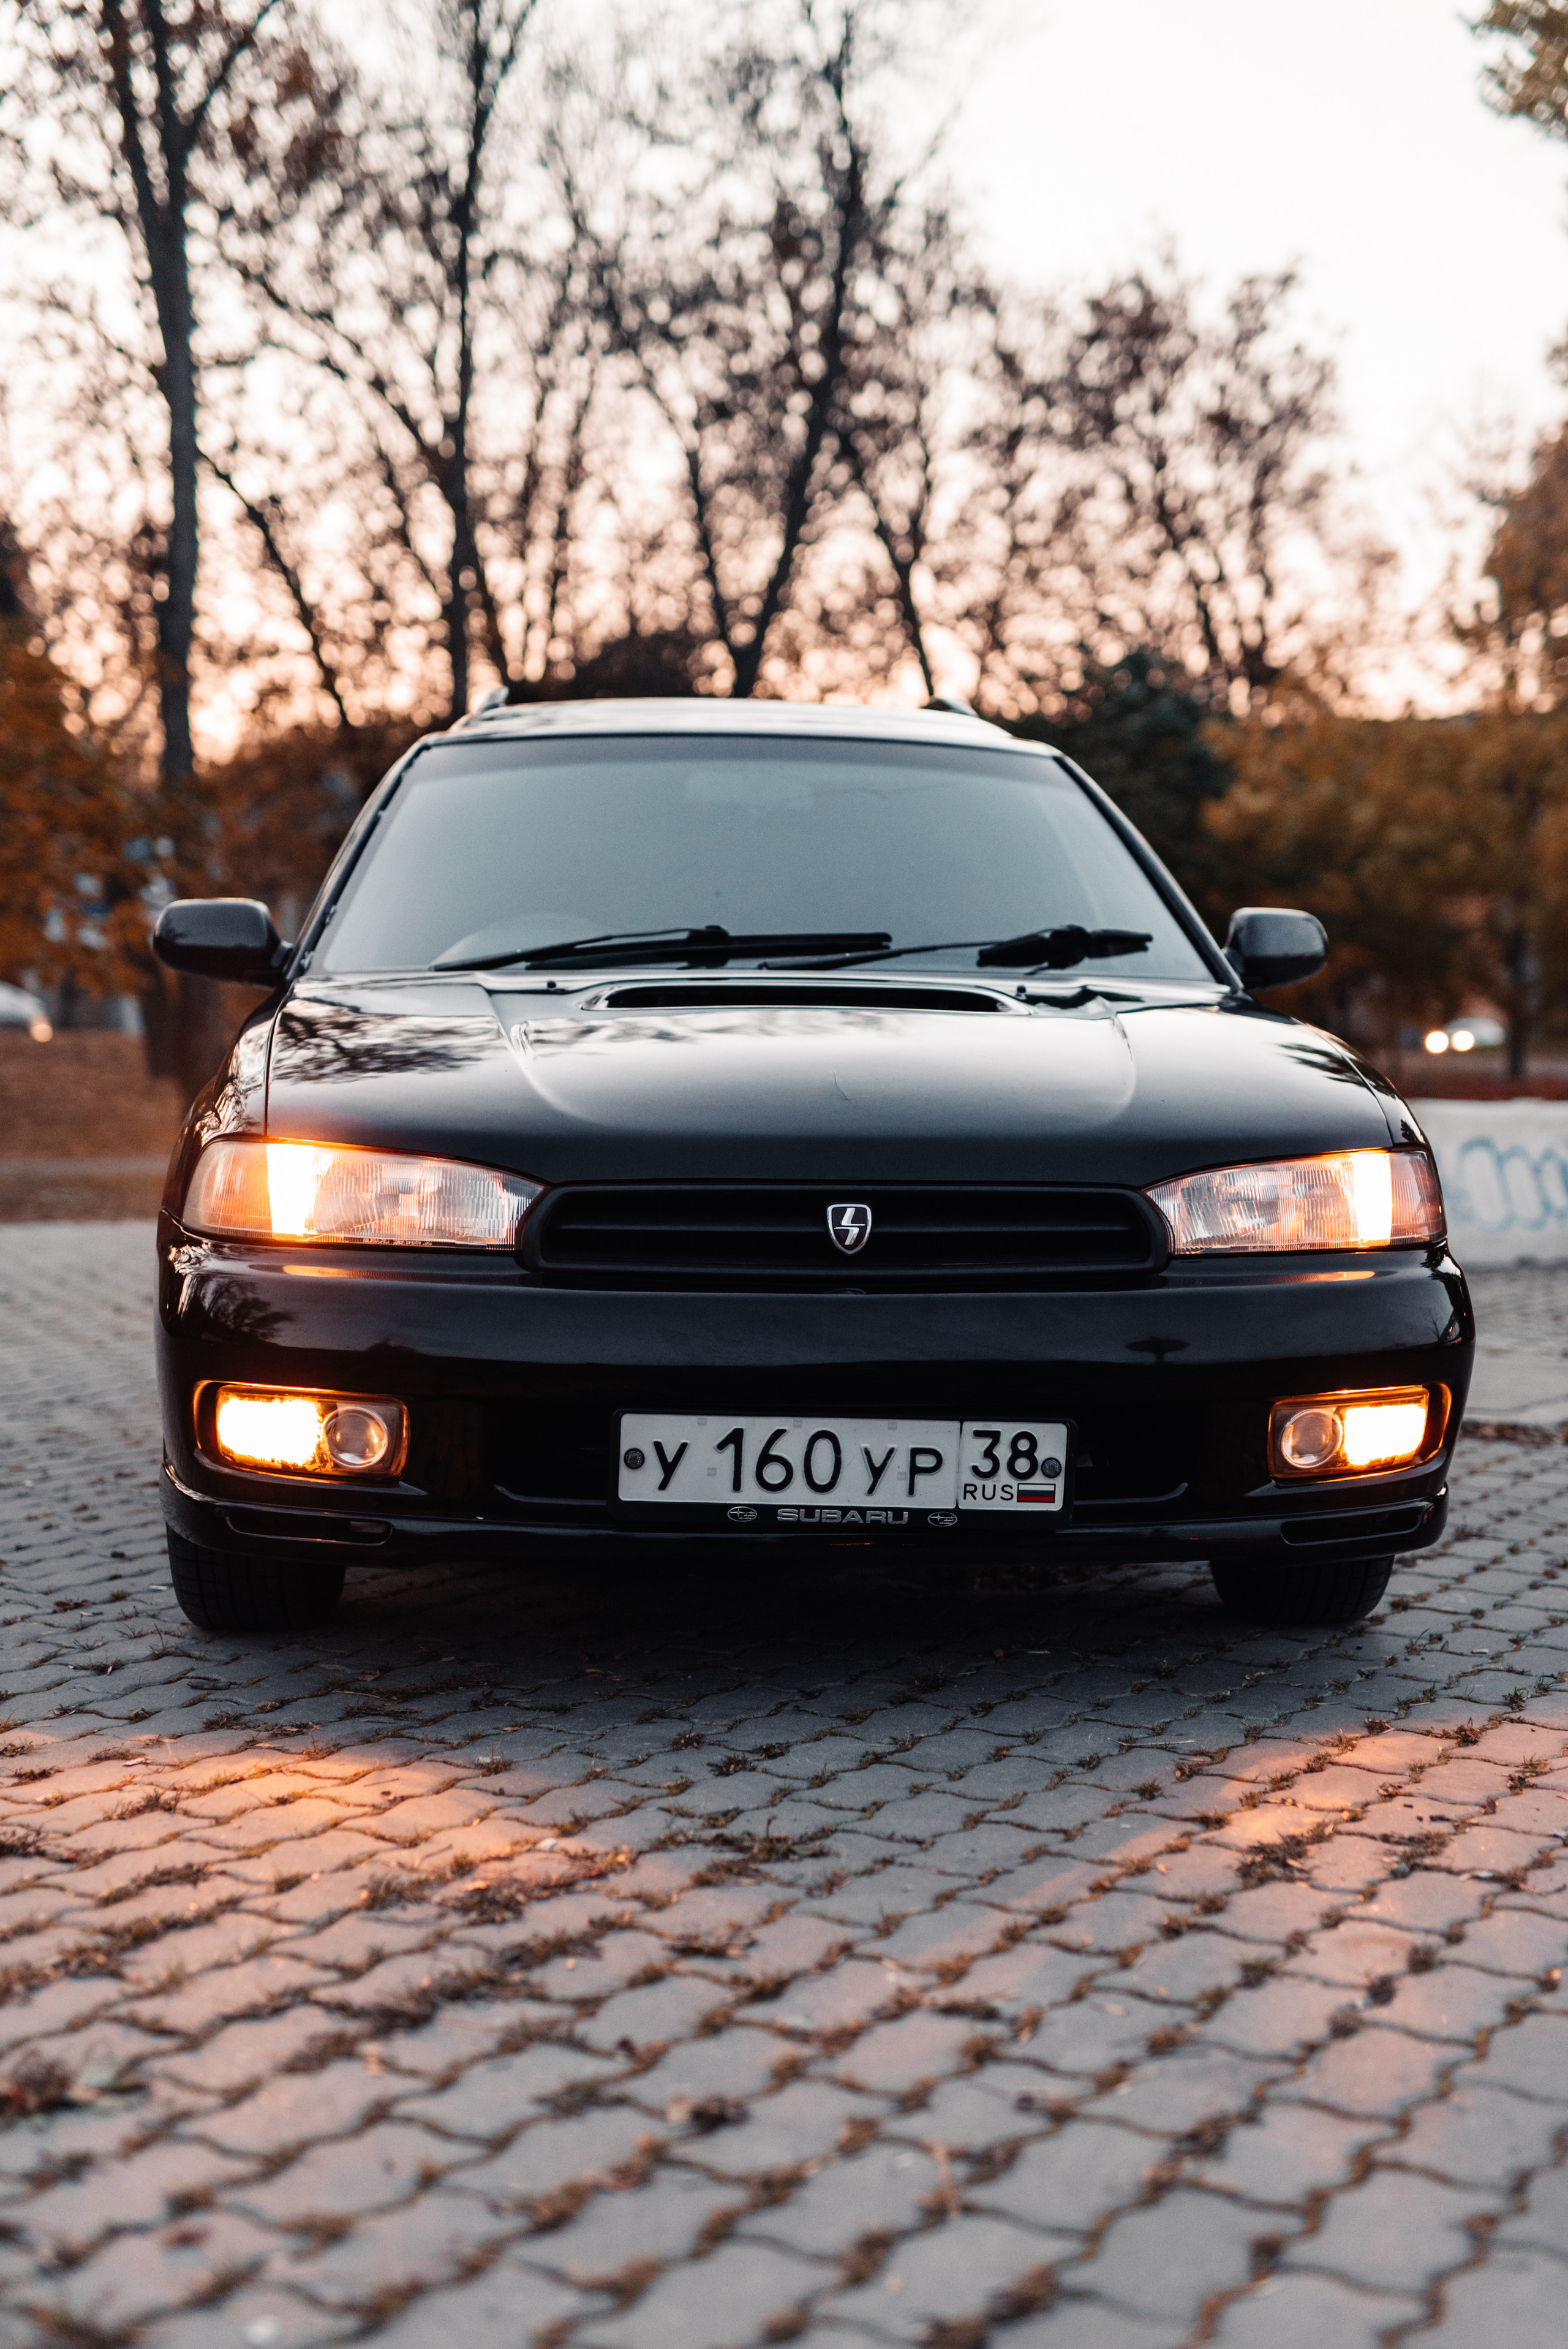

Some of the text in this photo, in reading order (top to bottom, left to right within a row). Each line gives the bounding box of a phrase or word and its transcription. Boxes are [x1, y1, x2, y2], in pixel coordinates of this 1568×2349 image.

[971, 1429, 1039, 1480] 38
[962, 1483, 1015, 1501] RUS
[777, 1508, 909, 1525] SUBARU
